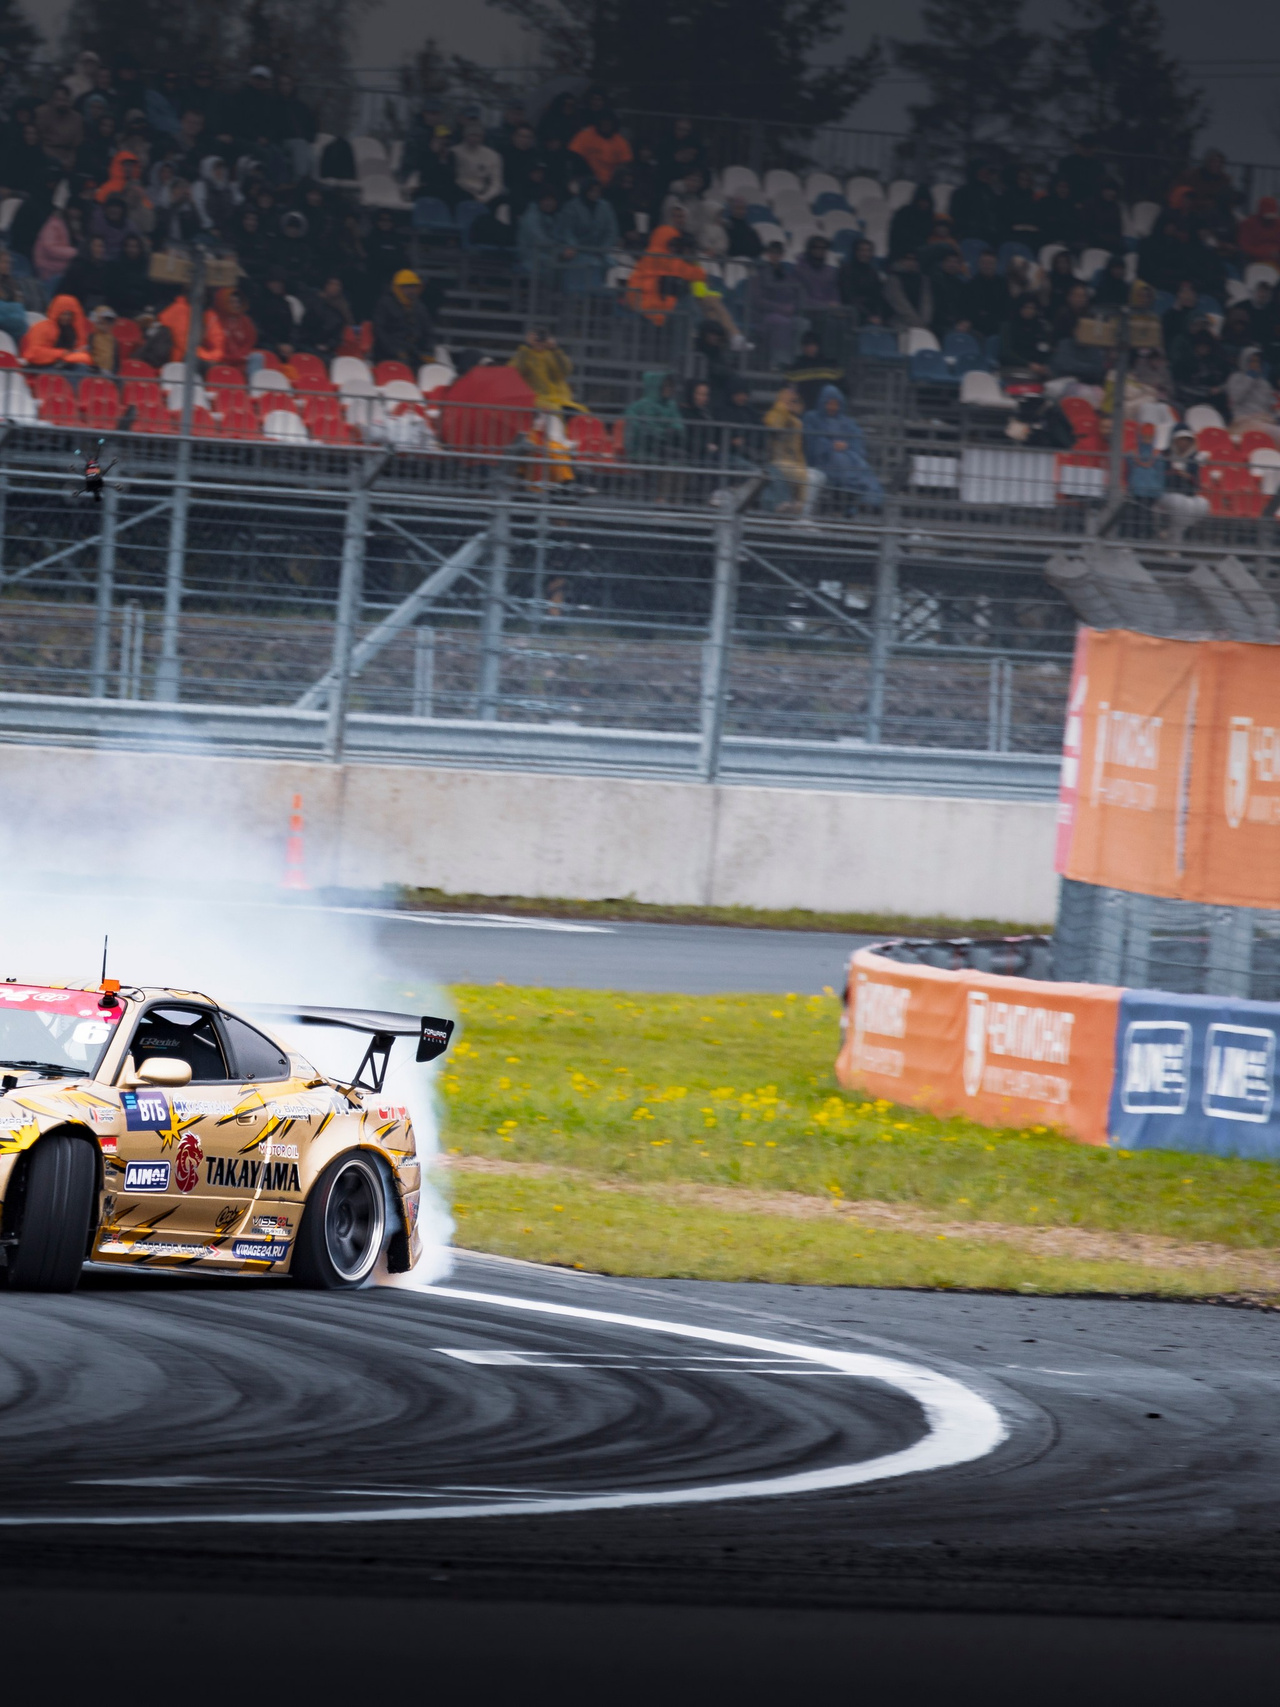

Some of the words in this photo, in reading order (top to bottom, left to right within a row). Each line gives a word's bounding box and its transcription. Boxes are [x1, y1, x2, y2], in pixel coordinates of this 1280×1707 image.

[72, 1021, 112, 1045] 6
[423, 1028, 447, 1039] FORWARD
[139, 1037, 181, 1047] GReddy
[137, 1099, 167, 1122] ВТБ
[259, 1143, 286, 1157] MOTOR
[286, 1145, 300, 1158] OIL
[127, 1167, 167, 1186] AIMOL
[206, 1156, 302, 1192] TAKAYAMA
[252, 1215, 294, 1228] VISSOL
[236, 1243, 286, 1257] VIRAGE24.RU
